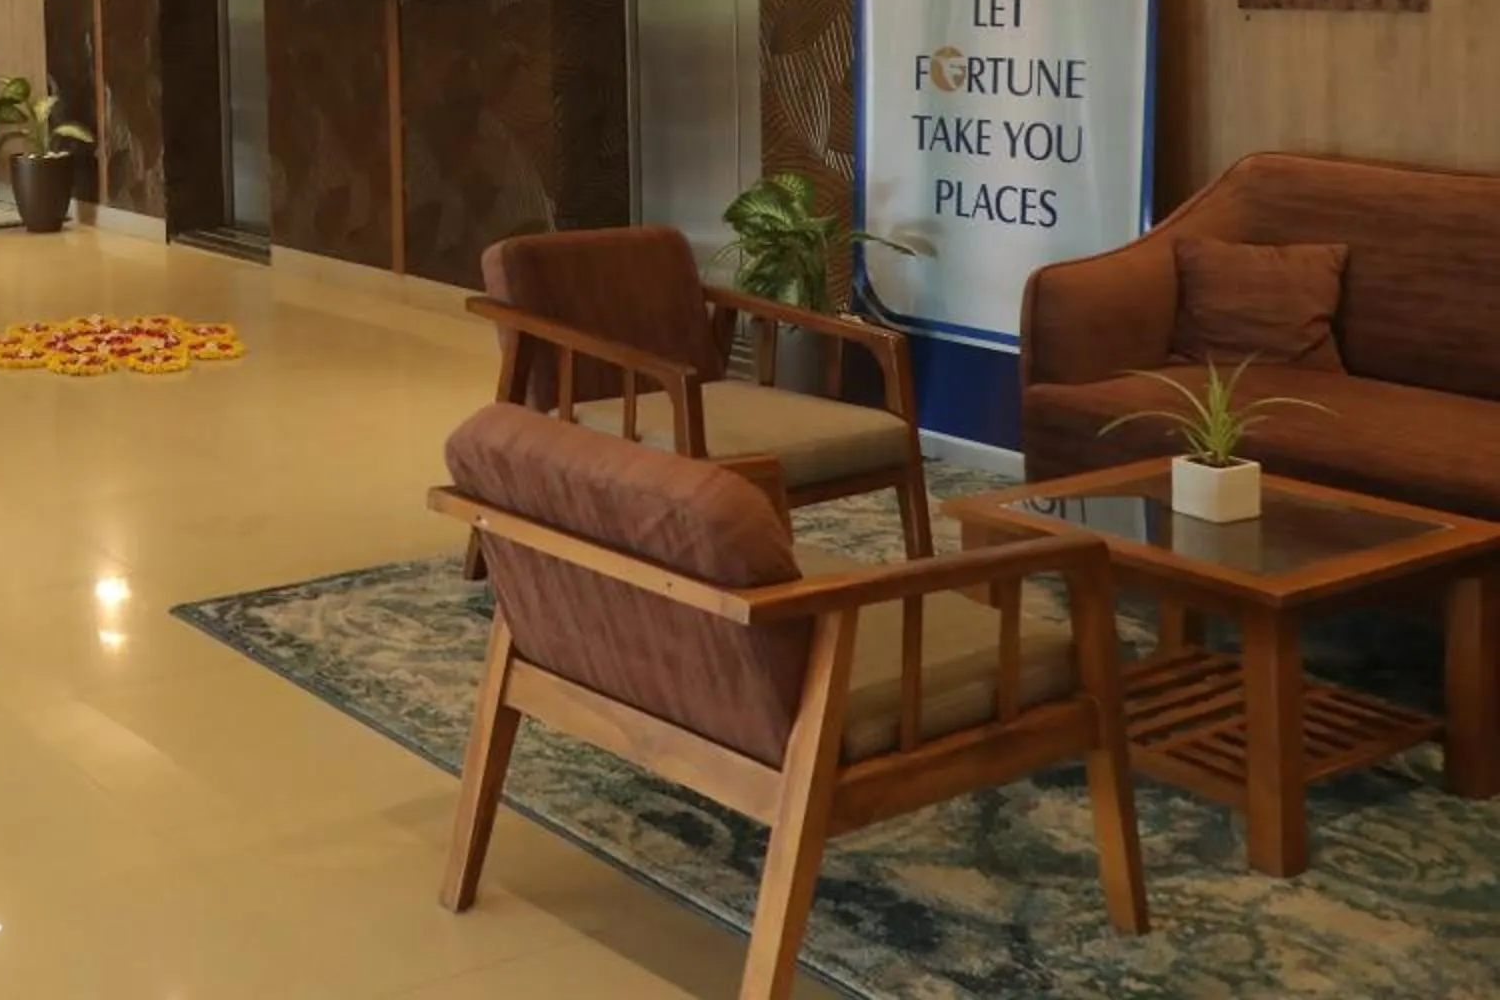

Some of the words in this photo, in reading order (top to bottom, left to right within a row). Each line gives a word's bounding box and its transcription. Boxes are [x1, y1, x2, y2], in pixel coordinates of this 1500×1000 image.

[914, 45, 1088, 99] FORTUNE
[911, 114, 993, 156] TAKE
[1002, 119, 1084, 164] YOU
[934, 178, 1059, 228] PLACES
